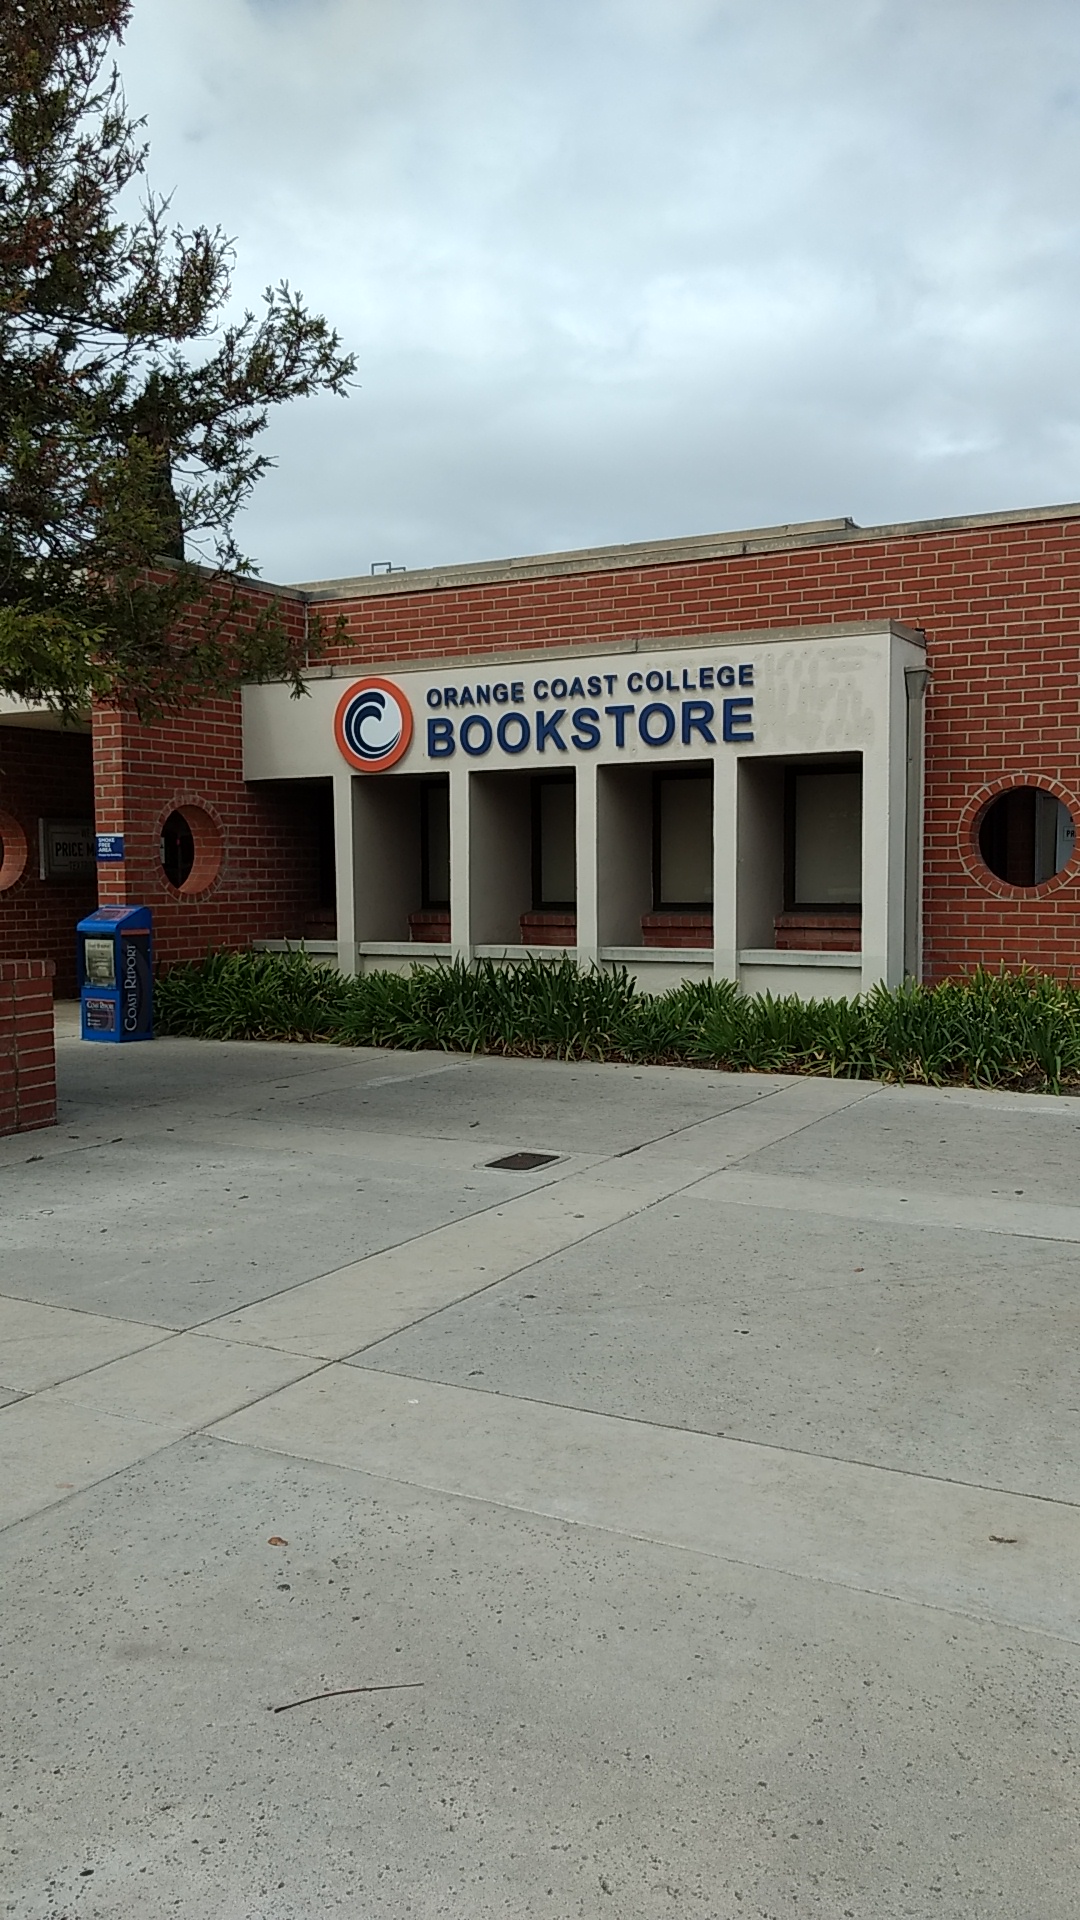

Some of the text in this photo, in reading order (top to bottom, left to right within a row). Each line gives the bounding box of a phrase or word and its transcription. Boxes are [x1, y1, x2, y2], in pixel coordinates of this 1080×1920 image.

[426, 663, 755, 708] ORANGE COAST COLLEGE
[426, 696, 755, 759] BOOKSTORE
[55, 842, 84, 857] PRICE
[124, 944, 137, 1031] COAST REPORT
